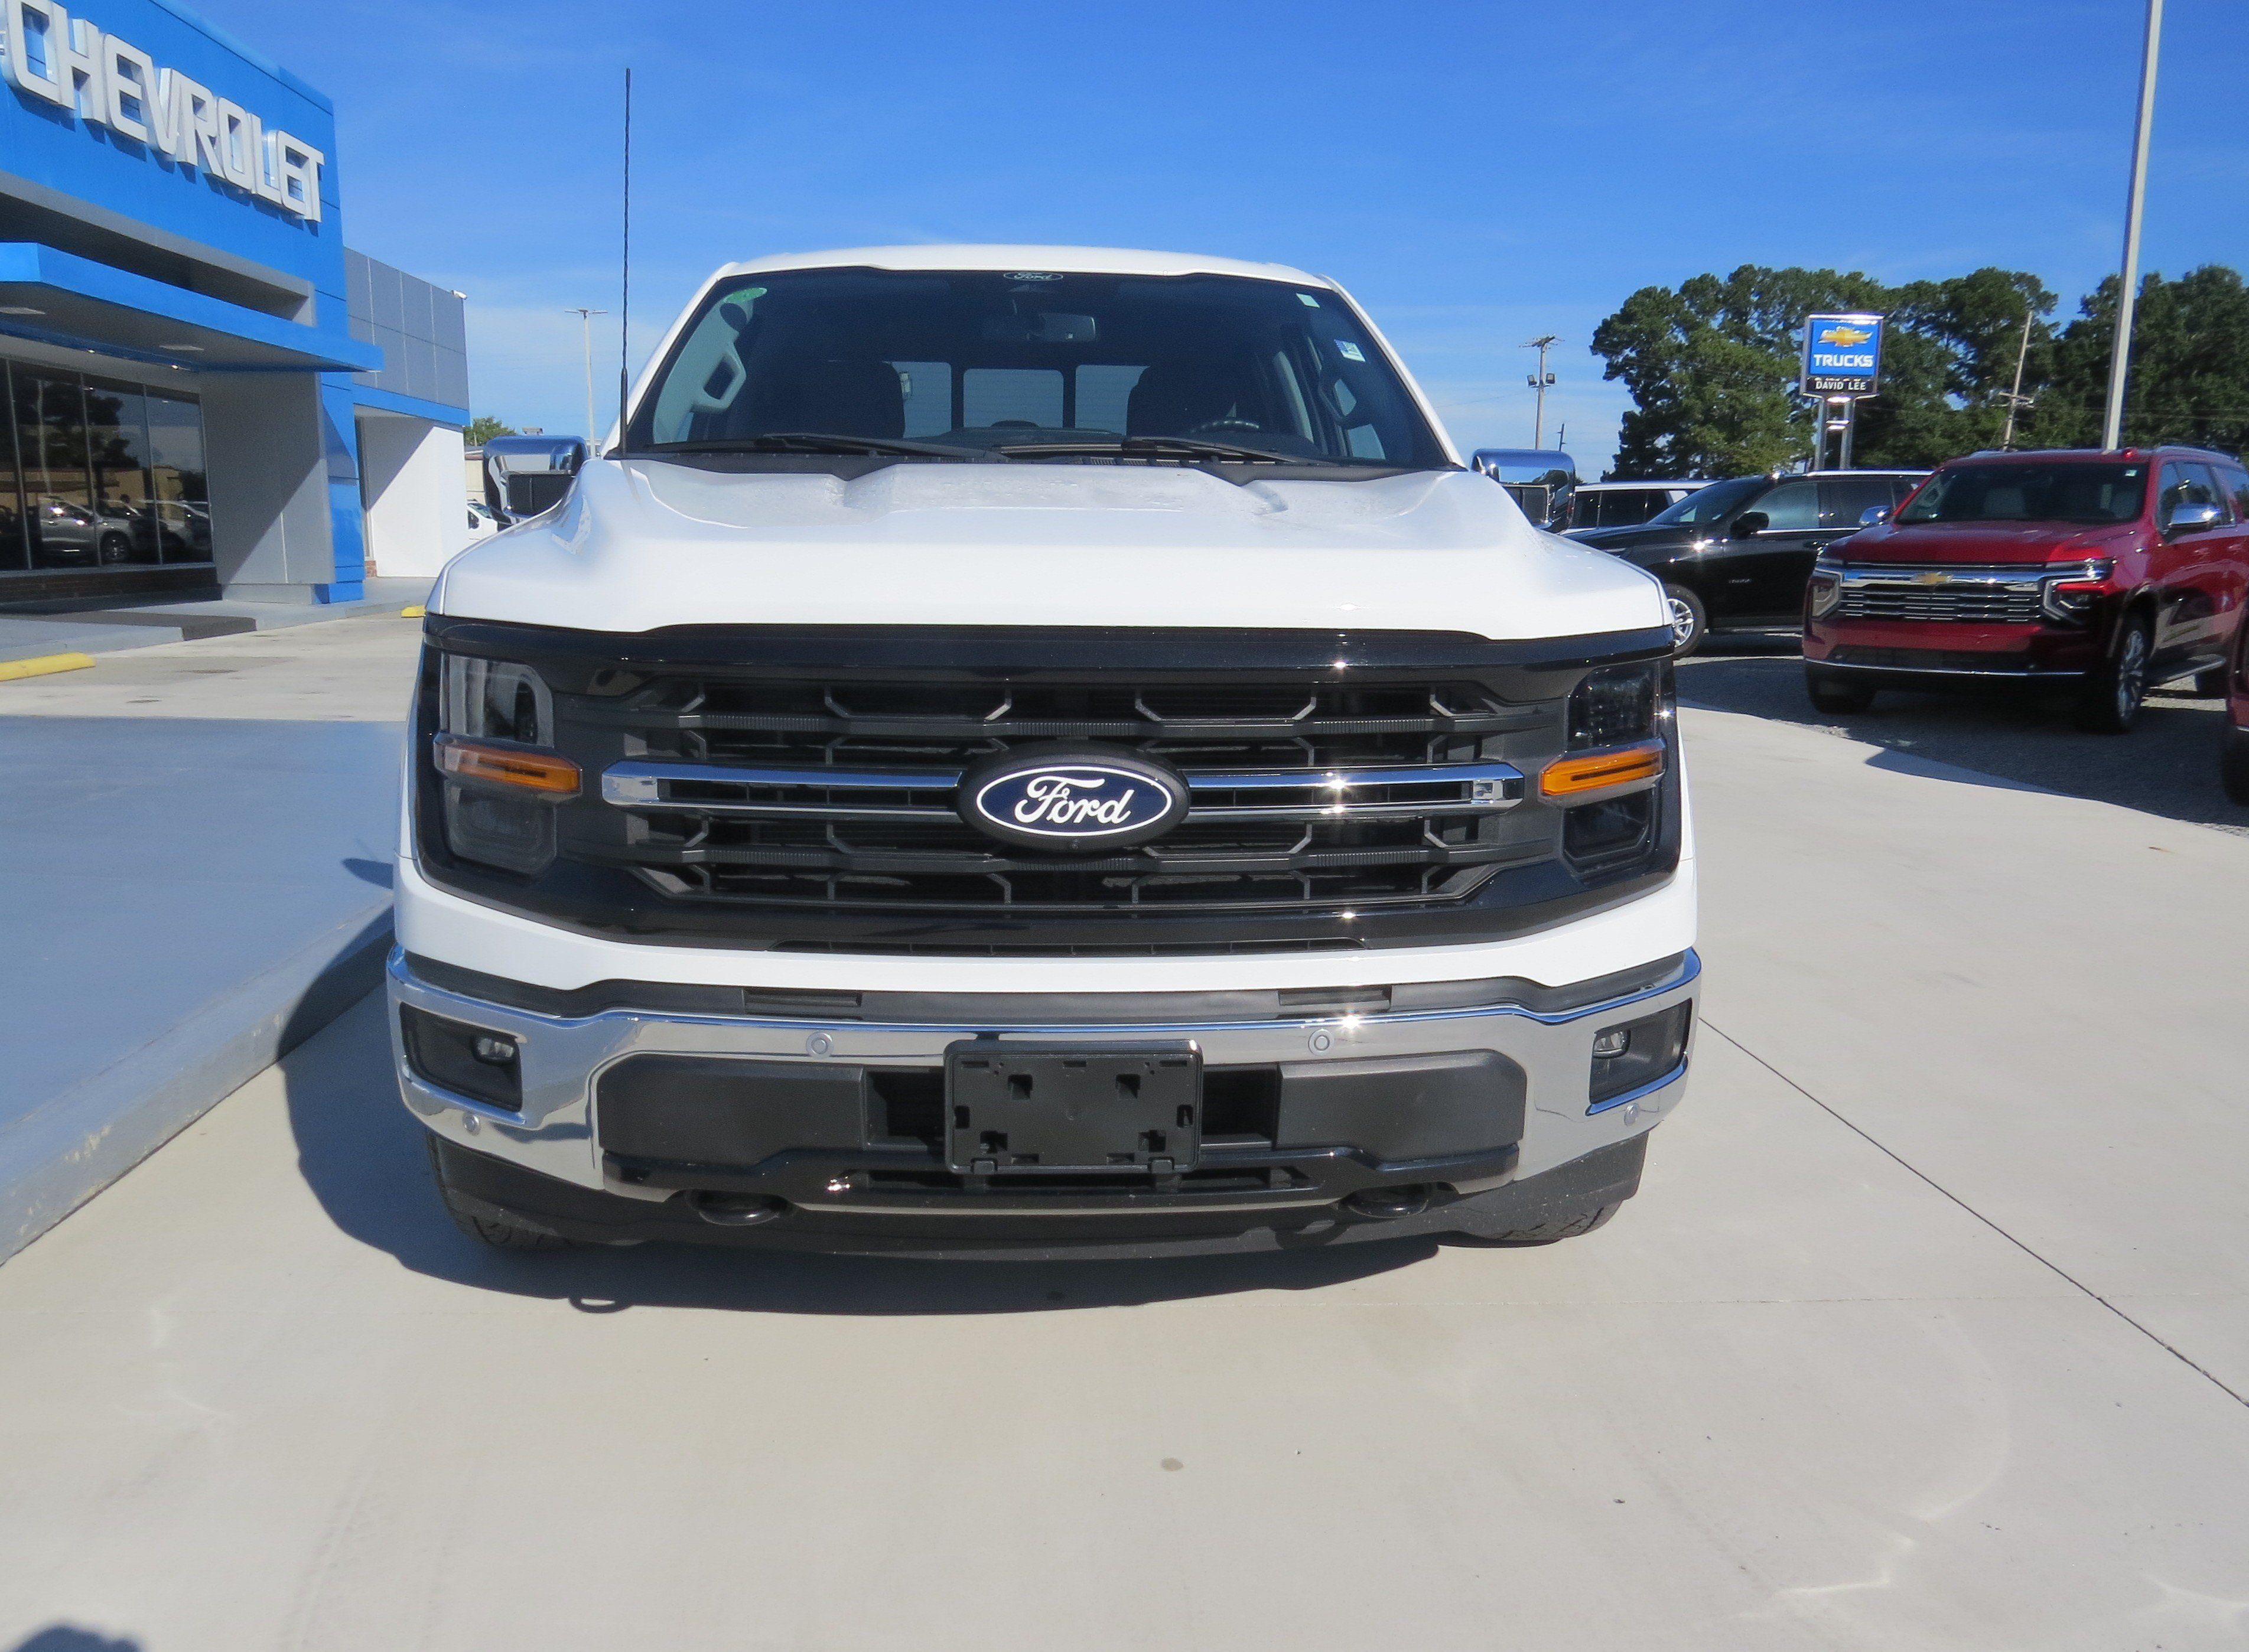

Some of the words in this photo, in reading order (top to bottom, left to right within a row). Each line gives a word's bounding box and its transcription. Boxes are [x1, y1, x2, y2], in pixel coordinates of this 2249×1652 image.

[3, 0, 324, 223] CHEVROLET
[1813, 354, 1874, 367] TRUCKS
[1815, 381, 1843, 390] DAVID
[1848, 381, 1867, 390] LEE
[1014, 776, 1135, 823] Ford
